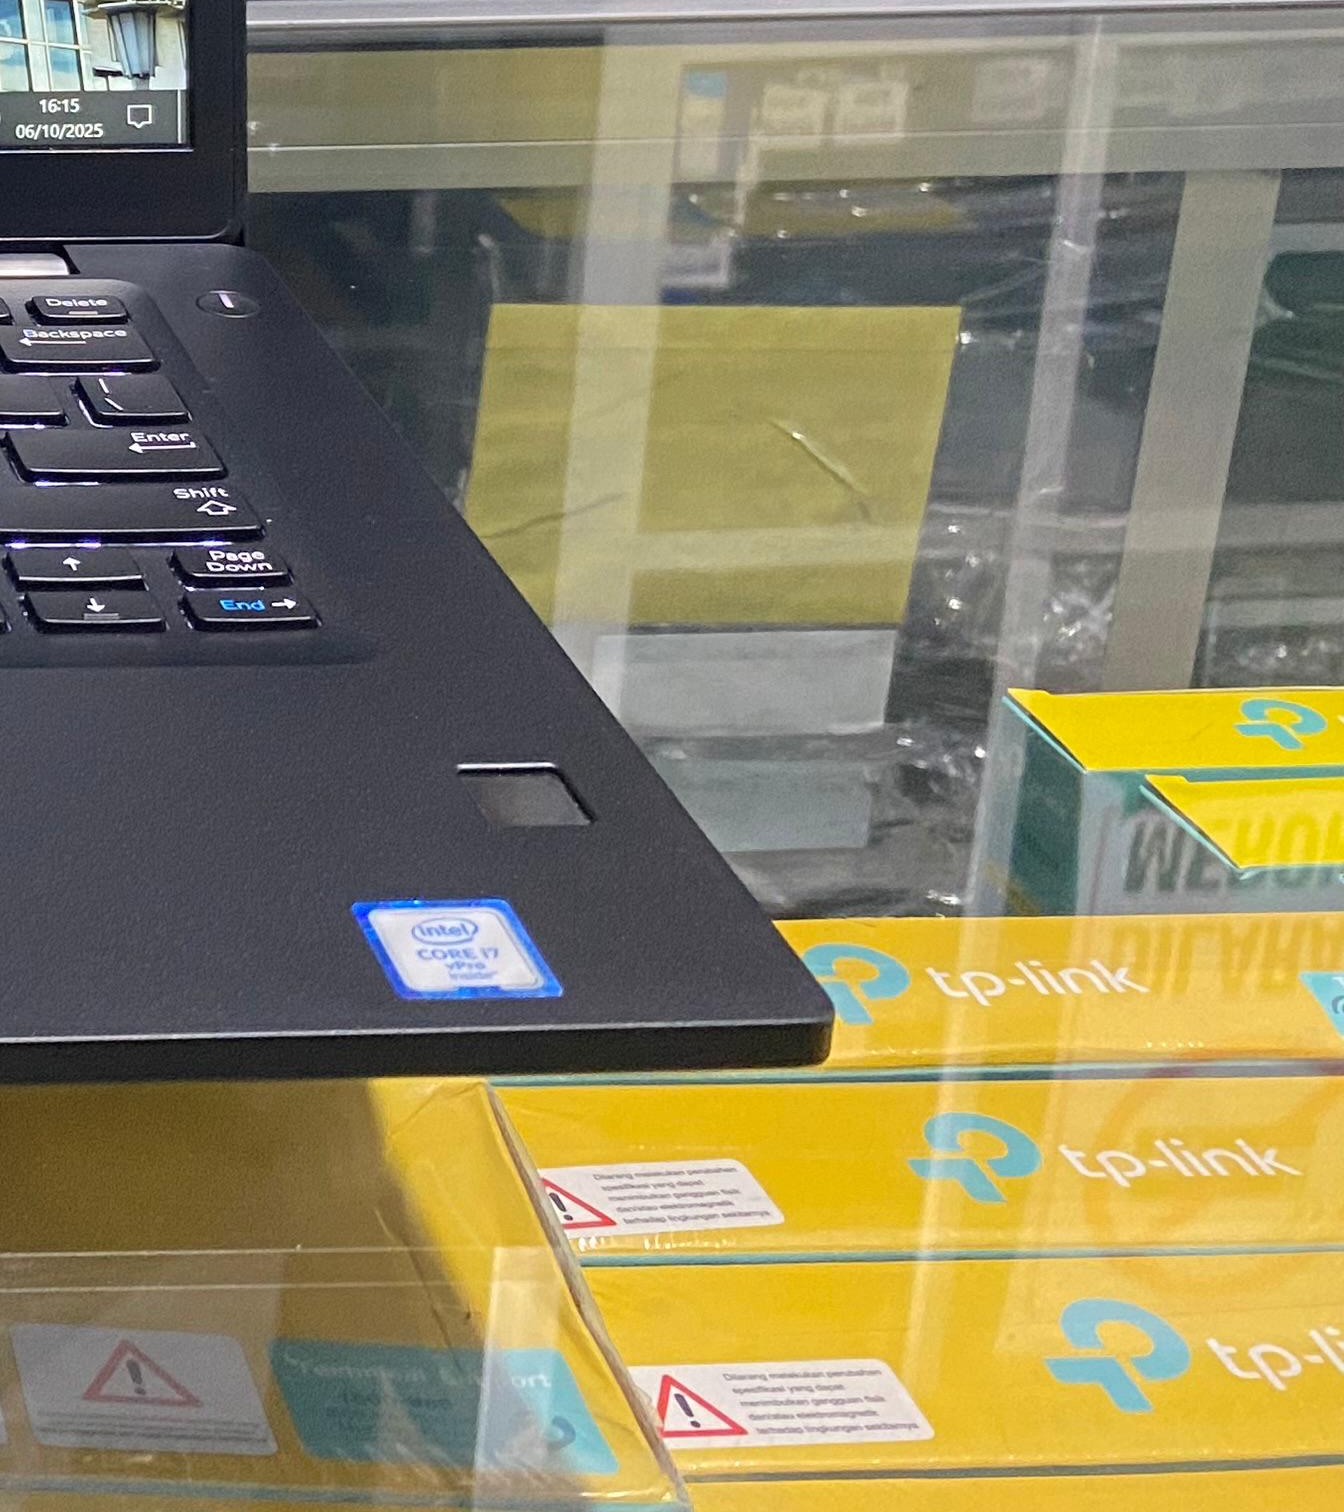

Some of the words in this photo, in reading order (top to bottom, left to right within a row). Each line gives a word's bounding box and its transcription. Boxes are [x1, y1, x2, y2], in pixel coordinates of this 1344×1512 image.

[38, 97, 81, 116] 16:15
[14, 120, 105, 141] 06/10/2025
[45, 297, 108, 308] Delete
[23, 328, 128, 340] Backspace
[130, 430, 191, 444] Enter
[173, 486, 230, 500] Shift
[209, 549, 266, 563] Page
[205, 559, 273, 572] Down
[218, 598, 266, 612] End
[416, 947, 477, 961] CORE
[445, 961, 487, 971] vPro
[925, 959, 1152, 1007] tp-link
[1058, 1138, 1304, 1188] tp-link
[1205, 1326, 1344, 1391] tp-l
